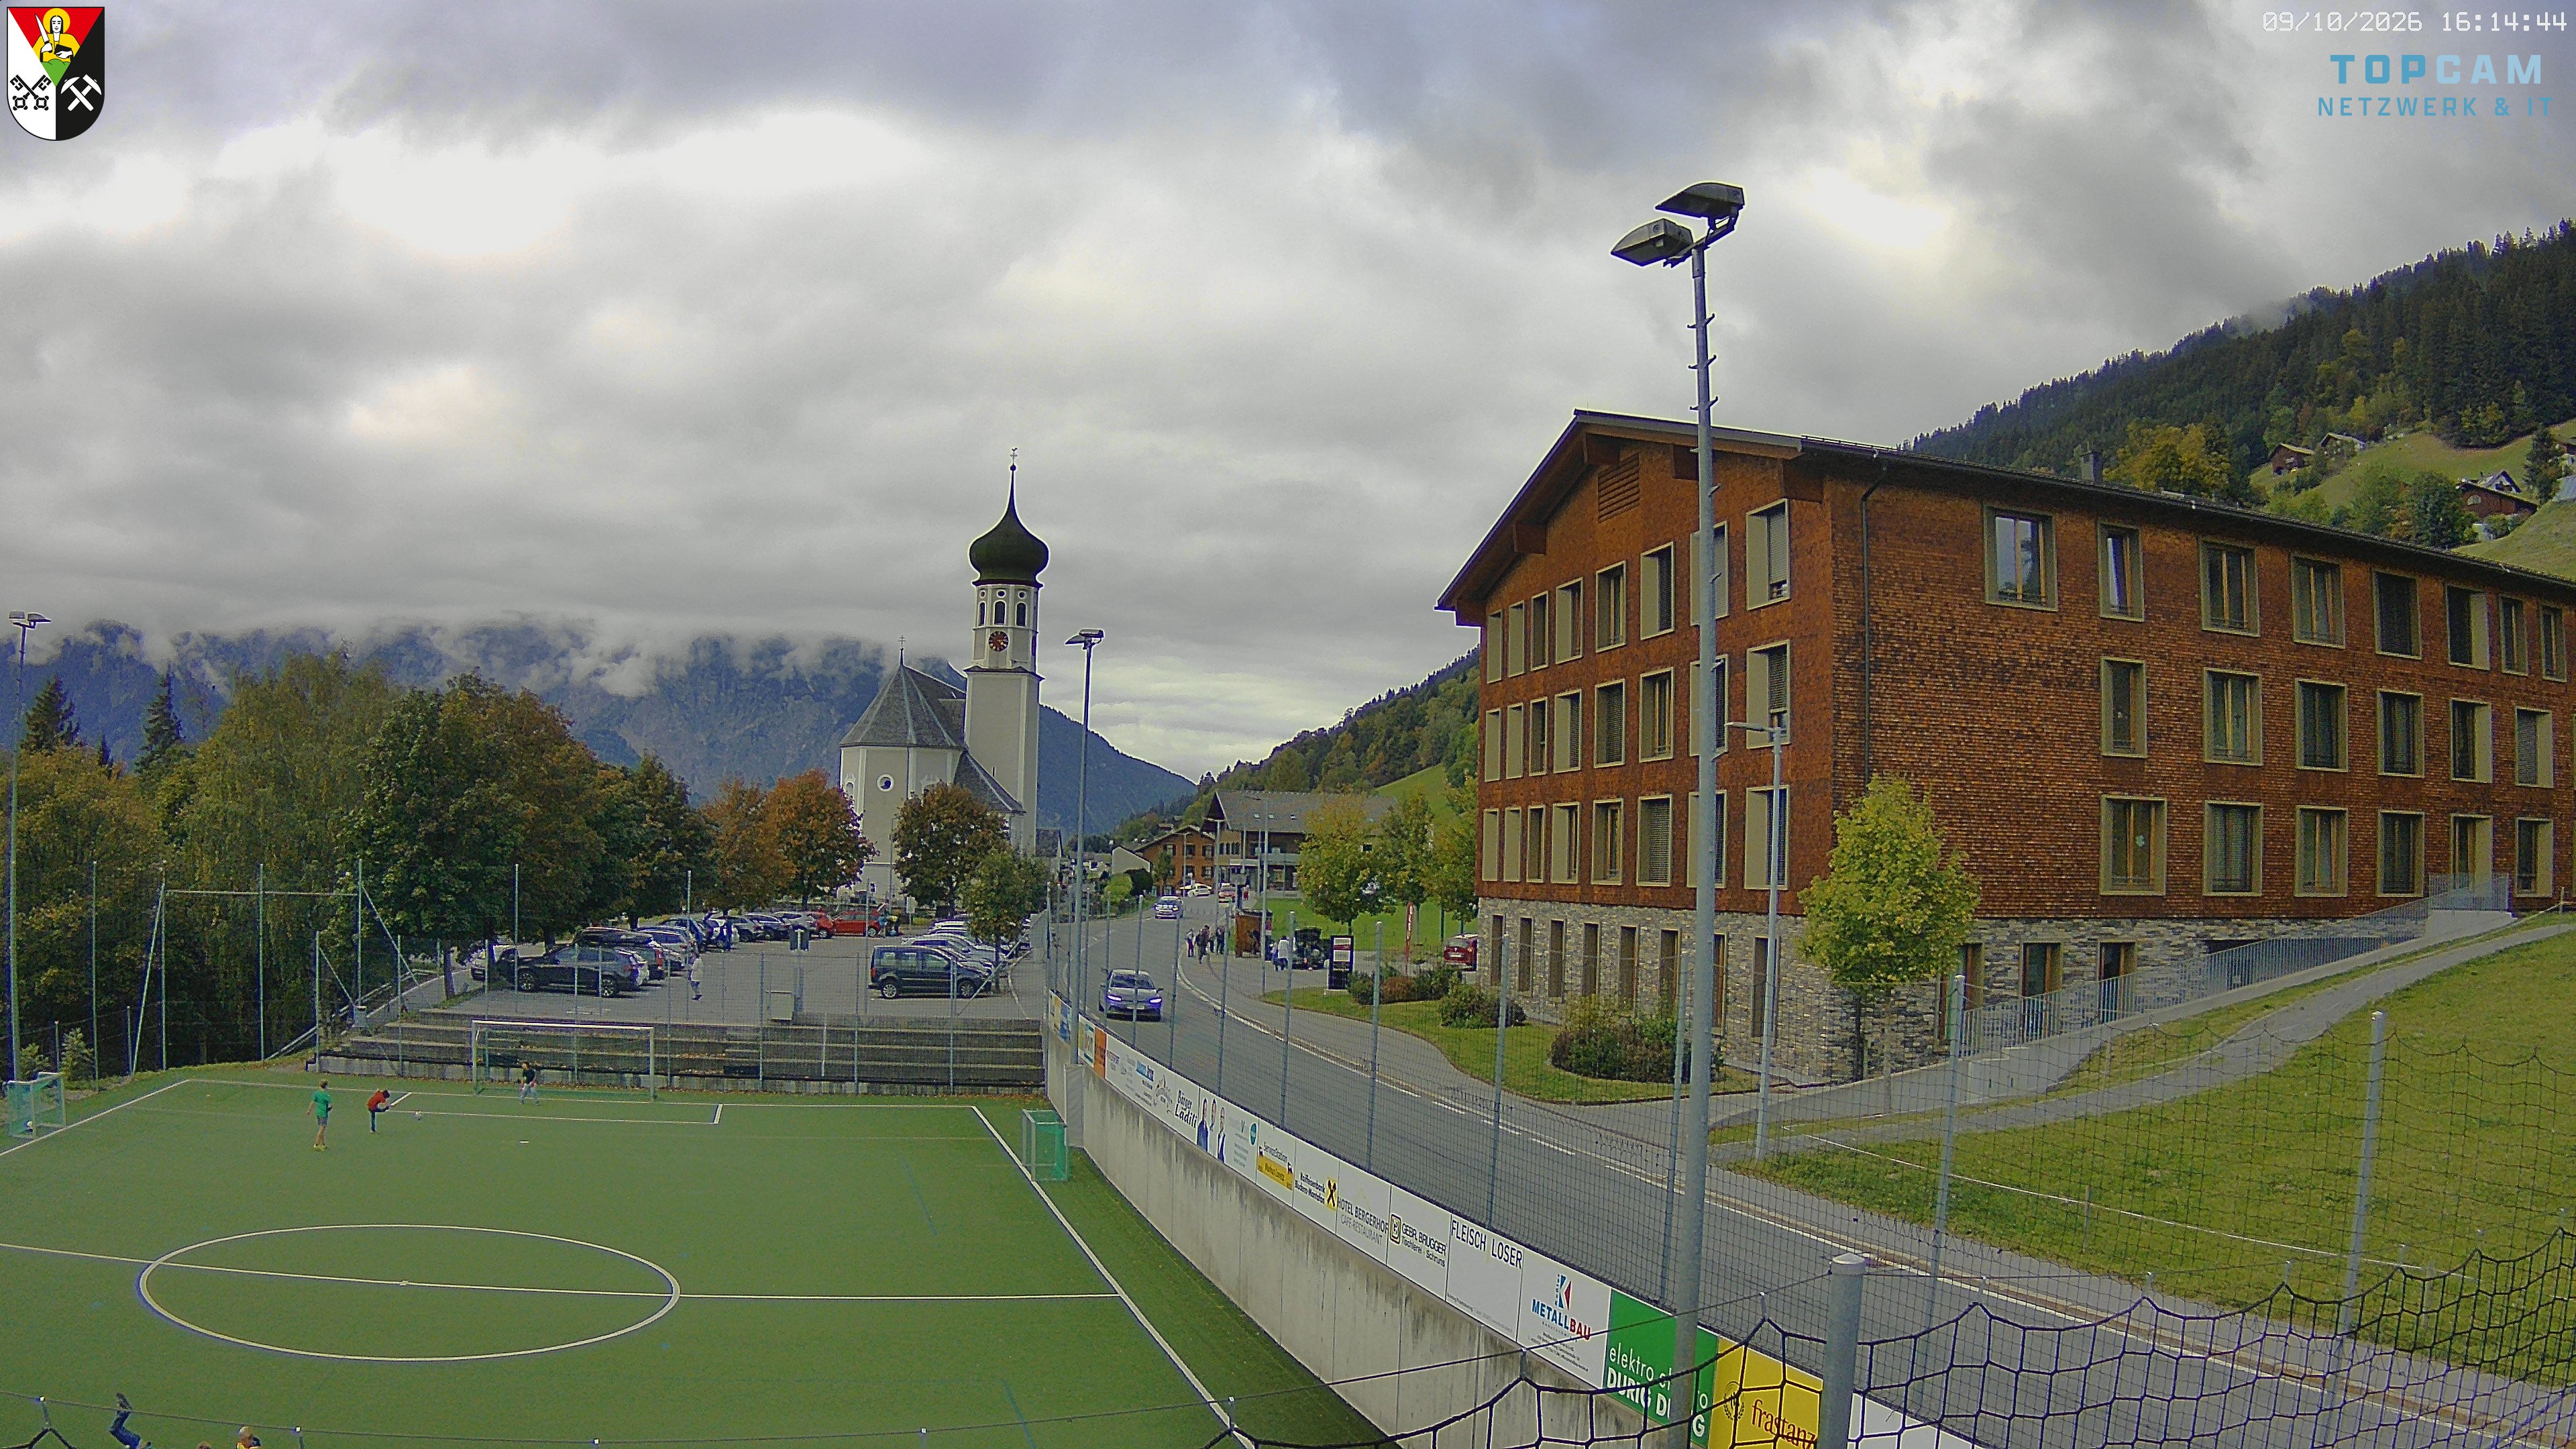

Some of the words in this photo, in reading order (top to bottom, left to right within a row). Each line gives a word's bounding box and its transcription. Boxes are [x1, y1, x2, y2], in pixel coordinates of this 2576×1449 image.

[1338, 1196, 1354, 1216] HOTEL
[1354, 1205, 1389, 1234] BERGERHOF
[1402, 1223, 1417, 1241] GEBR.
[1418, 1232, 1446, 1256] BRUGGER
[1426, 1250, 1445, 1267] Schruns
[1451, 1220, 1487, 1252] FLEISCH
[1491, 1238, 1523, 1269] LOSER
[1532, 1298, 1592, 1340] METALLBAU
[1609, 1342, 1654, 1382] elektro
